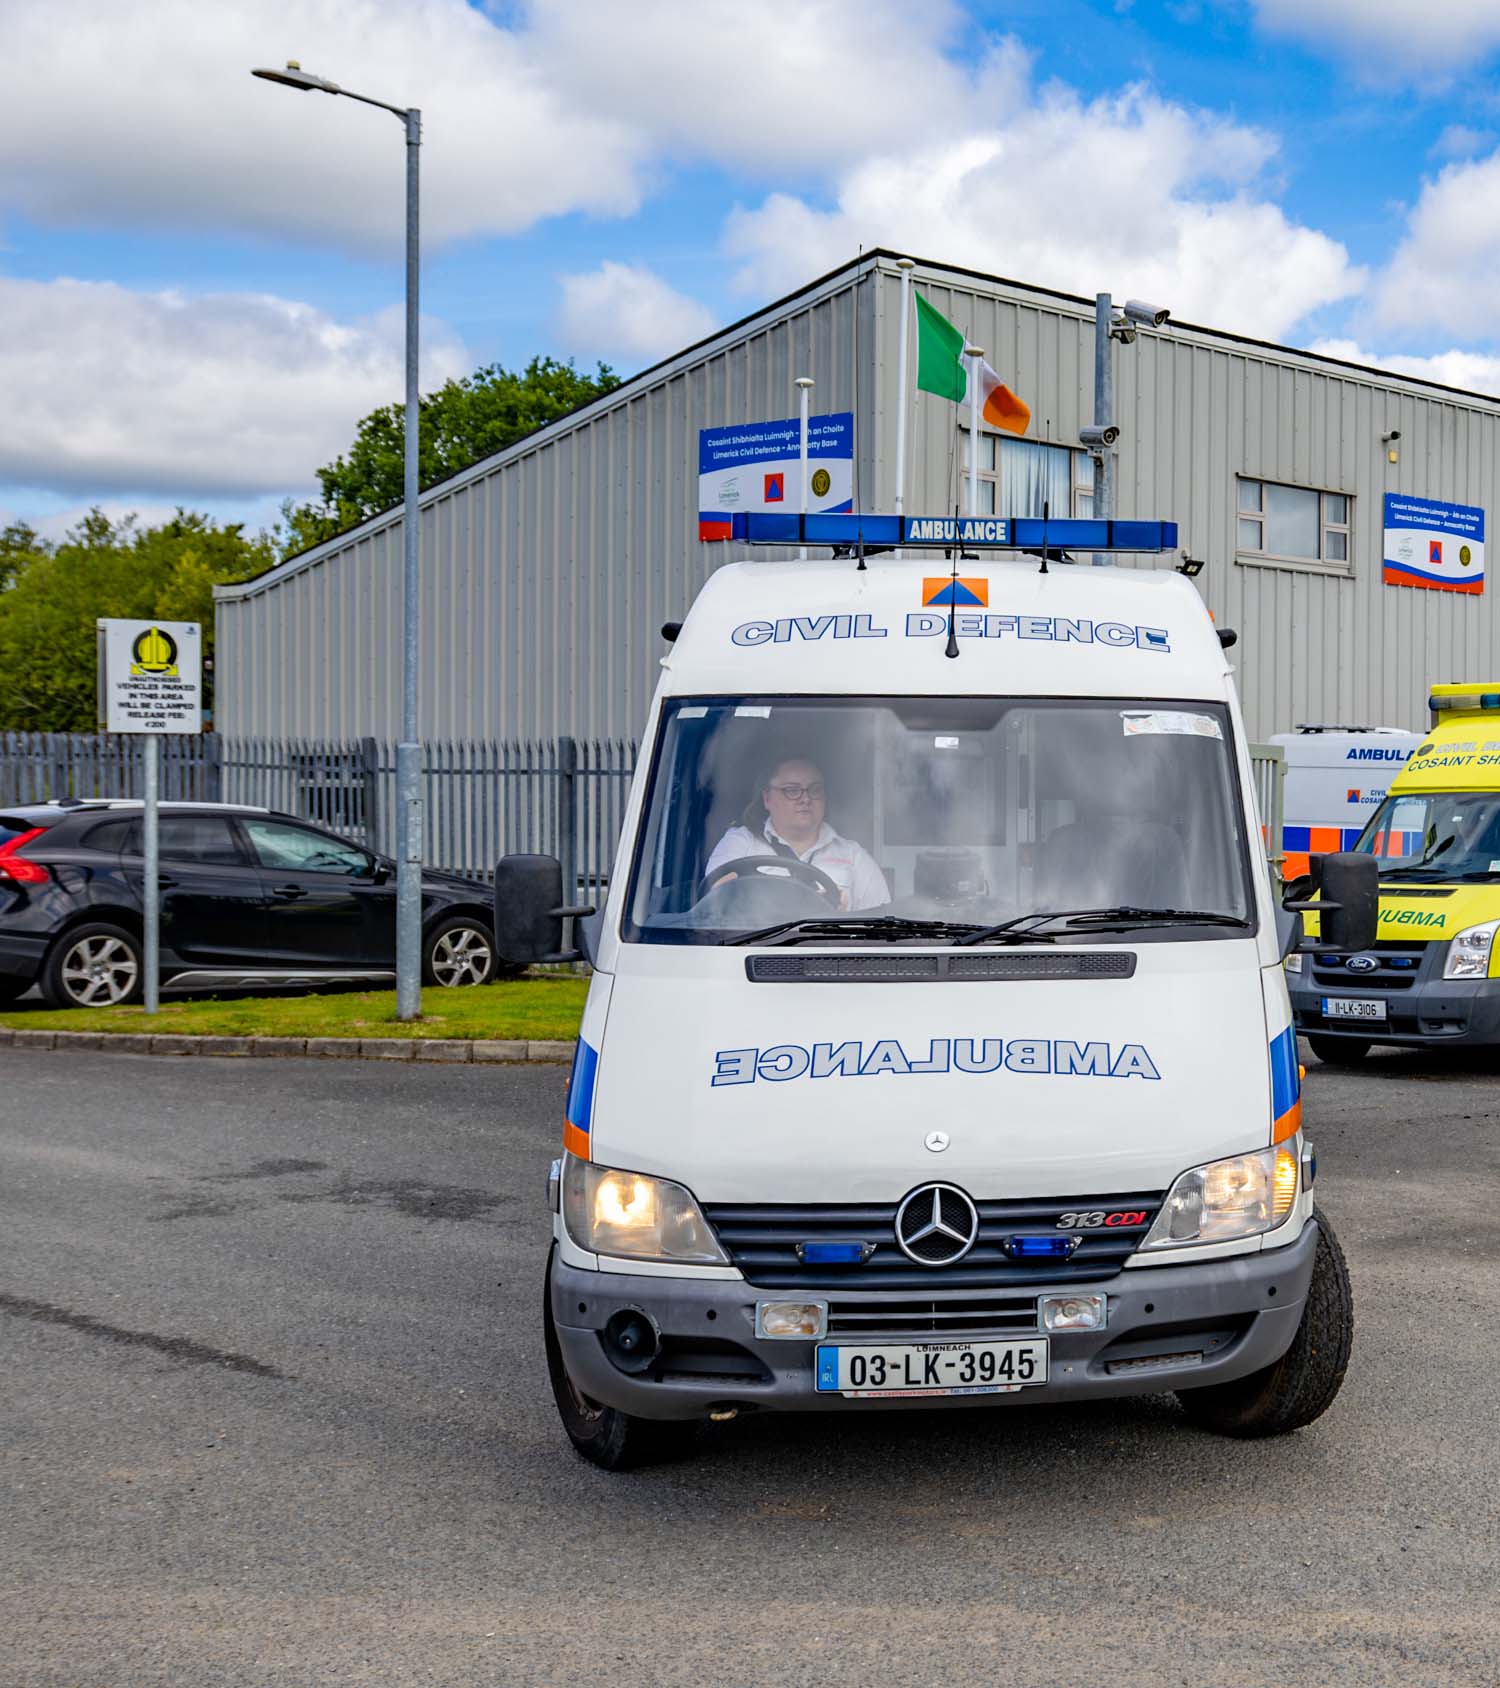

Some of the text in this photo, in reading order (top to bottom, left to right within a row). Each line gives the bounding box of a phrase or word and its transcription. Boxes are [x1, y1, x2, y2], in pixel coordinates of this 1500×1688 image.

[764, 431, 794, 442] Luimnigh
[713, 449, 739, 459] Limerick
[740, 447, 754, 456] Civil
[754, 445, 781, 455] Defence
[821, 439, 838, 448] Base
[909, 519, 1007, 541] AMBULANCE
[731, 612, 1171, 653] CIVIL DEFENCE
[1408, 755, 1474, 772] COSAINT
[822, 1372, 834, 1384] IRL
[850, 1349, 1035, 1387] 03-LK-3945
